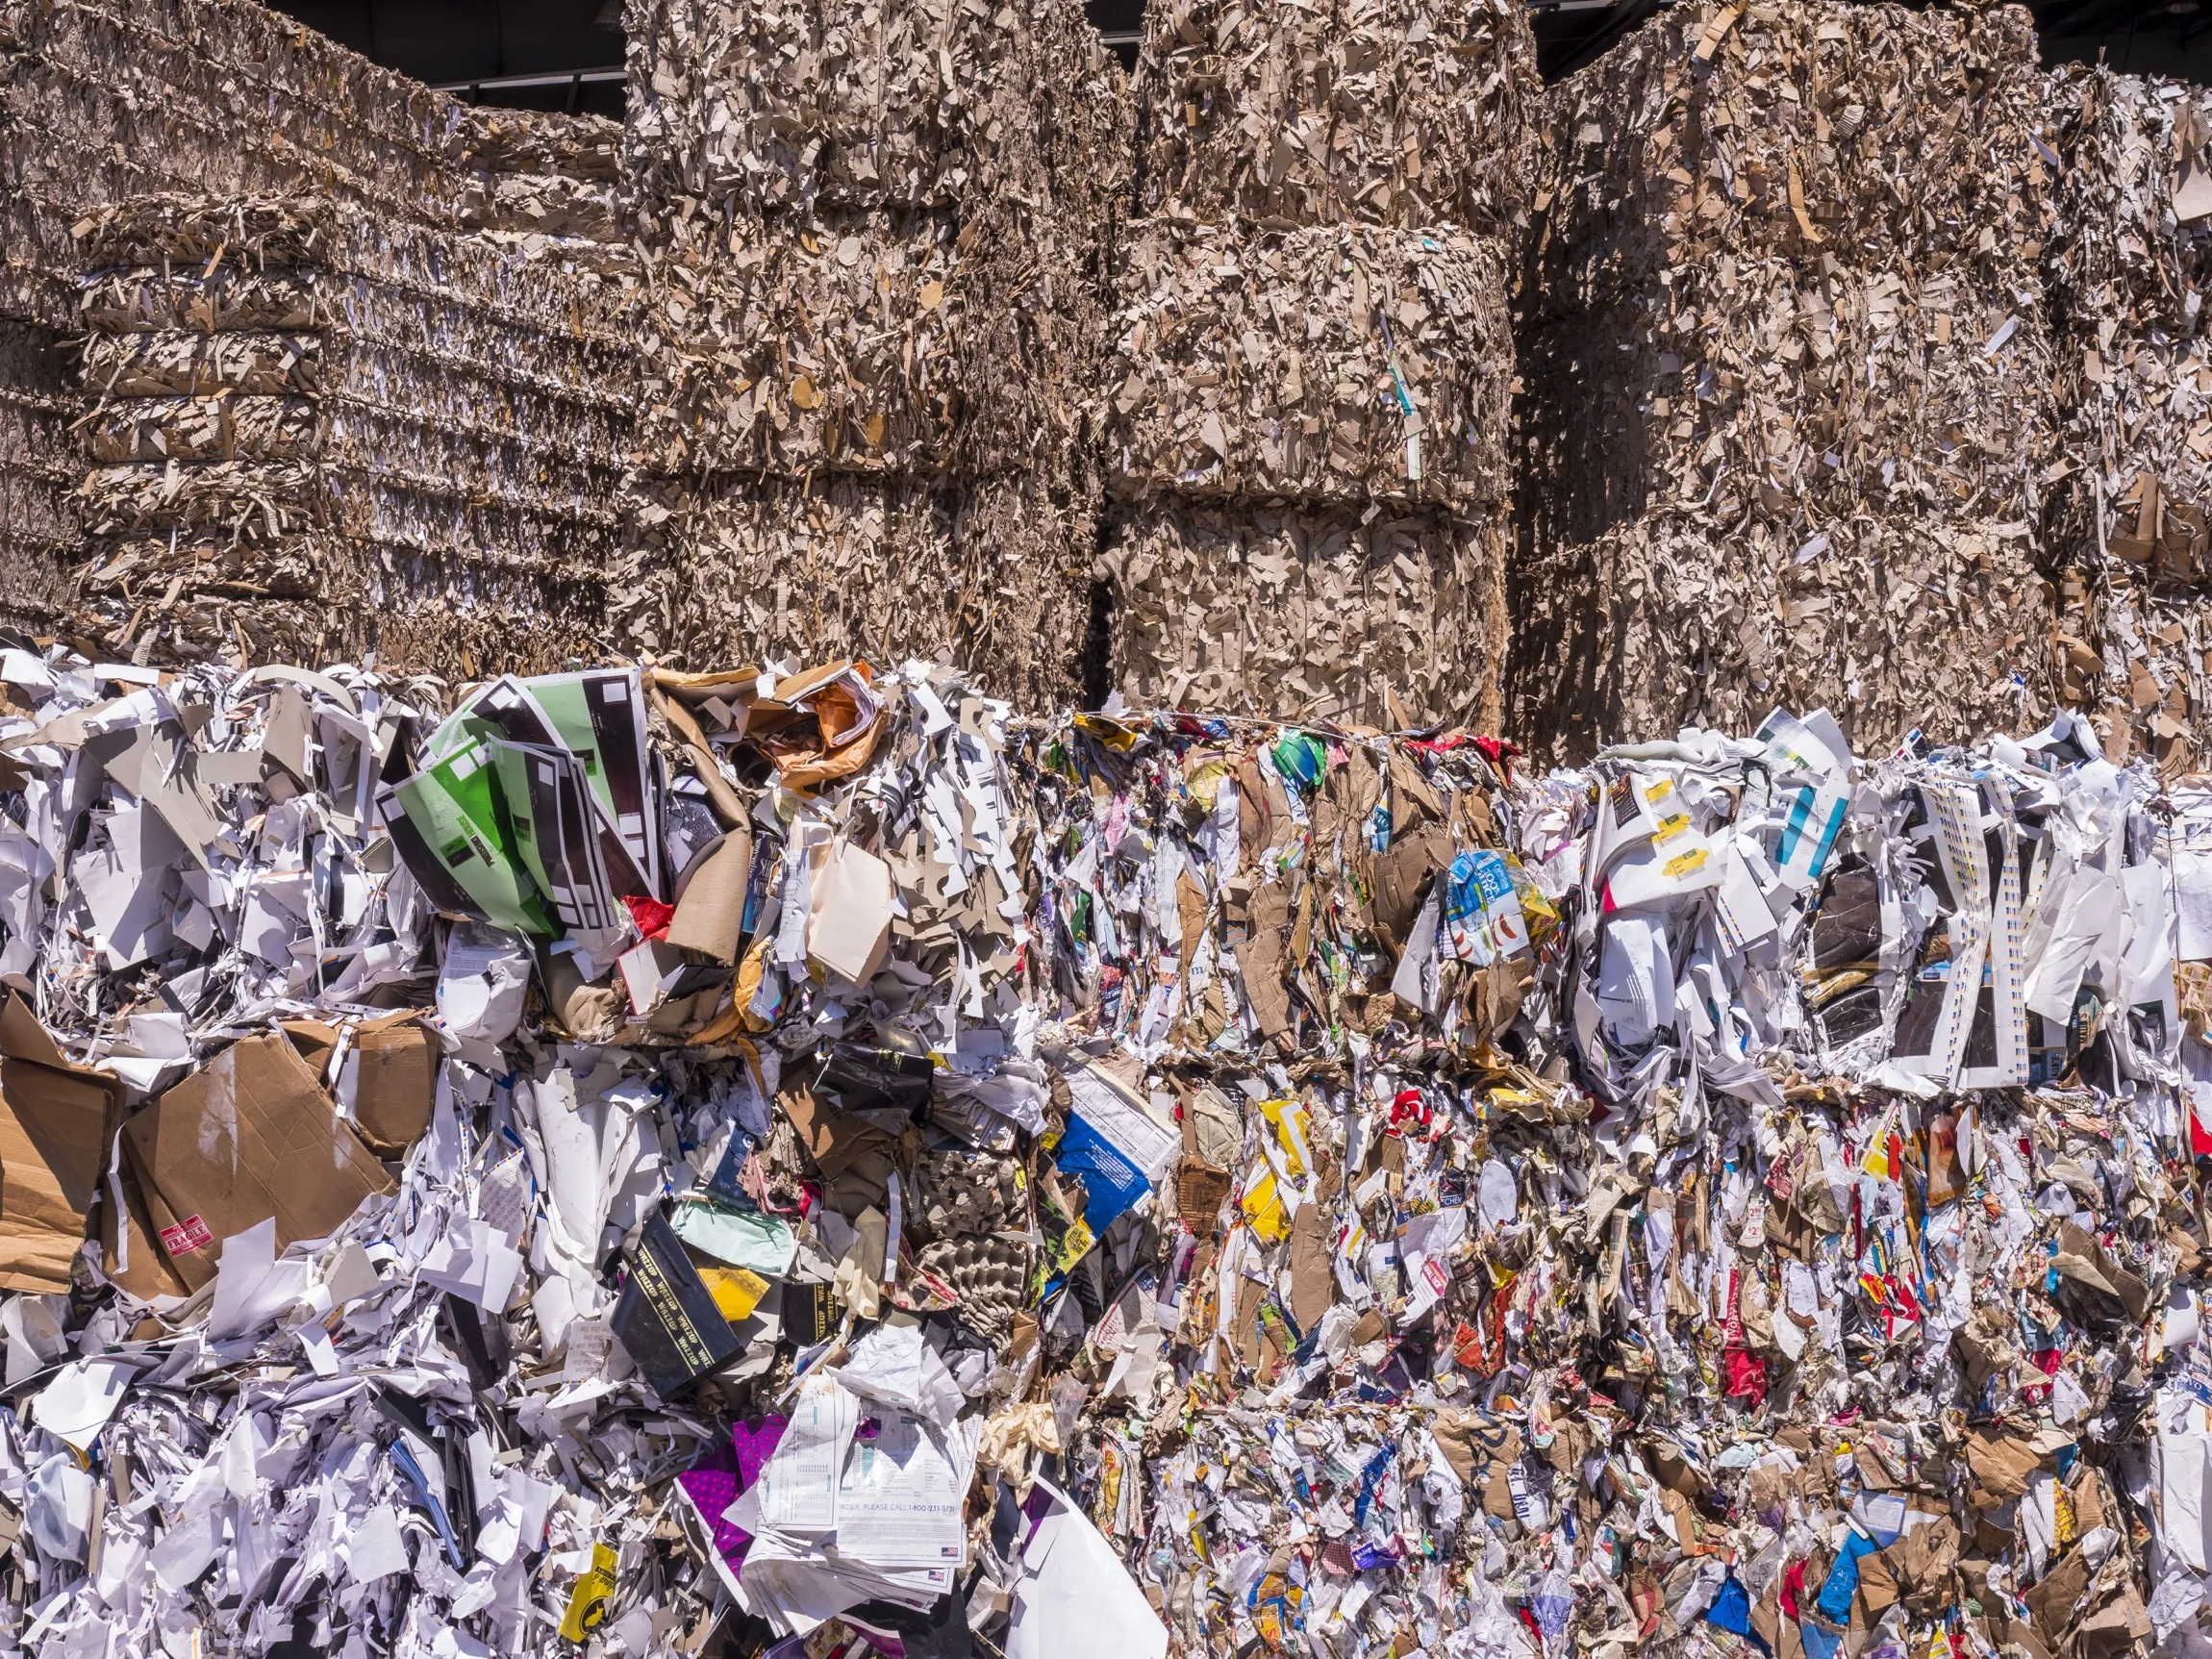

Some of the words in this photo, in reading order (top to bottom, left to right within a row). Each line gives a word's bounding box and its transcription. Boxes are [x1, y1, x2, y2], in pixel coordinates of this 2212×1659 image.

[1483, 867, 1500, 895] 100%
[167, 1225, 205, 1249] FRAGILE
[638, 1248, 658, 1277] WAZZUP
[657, 1281, 678, 1311] WAZZUP
[677, 1314, 698, 1344] WAZZUP
[637, 1269, 659, 1297] WAZZUP
[658, 1301, 678, 1331] WAZZUP
[678, 1336, 699, 1366] WAZZUP
[908, 1504, 955, 1513] 1-800-235-5731
